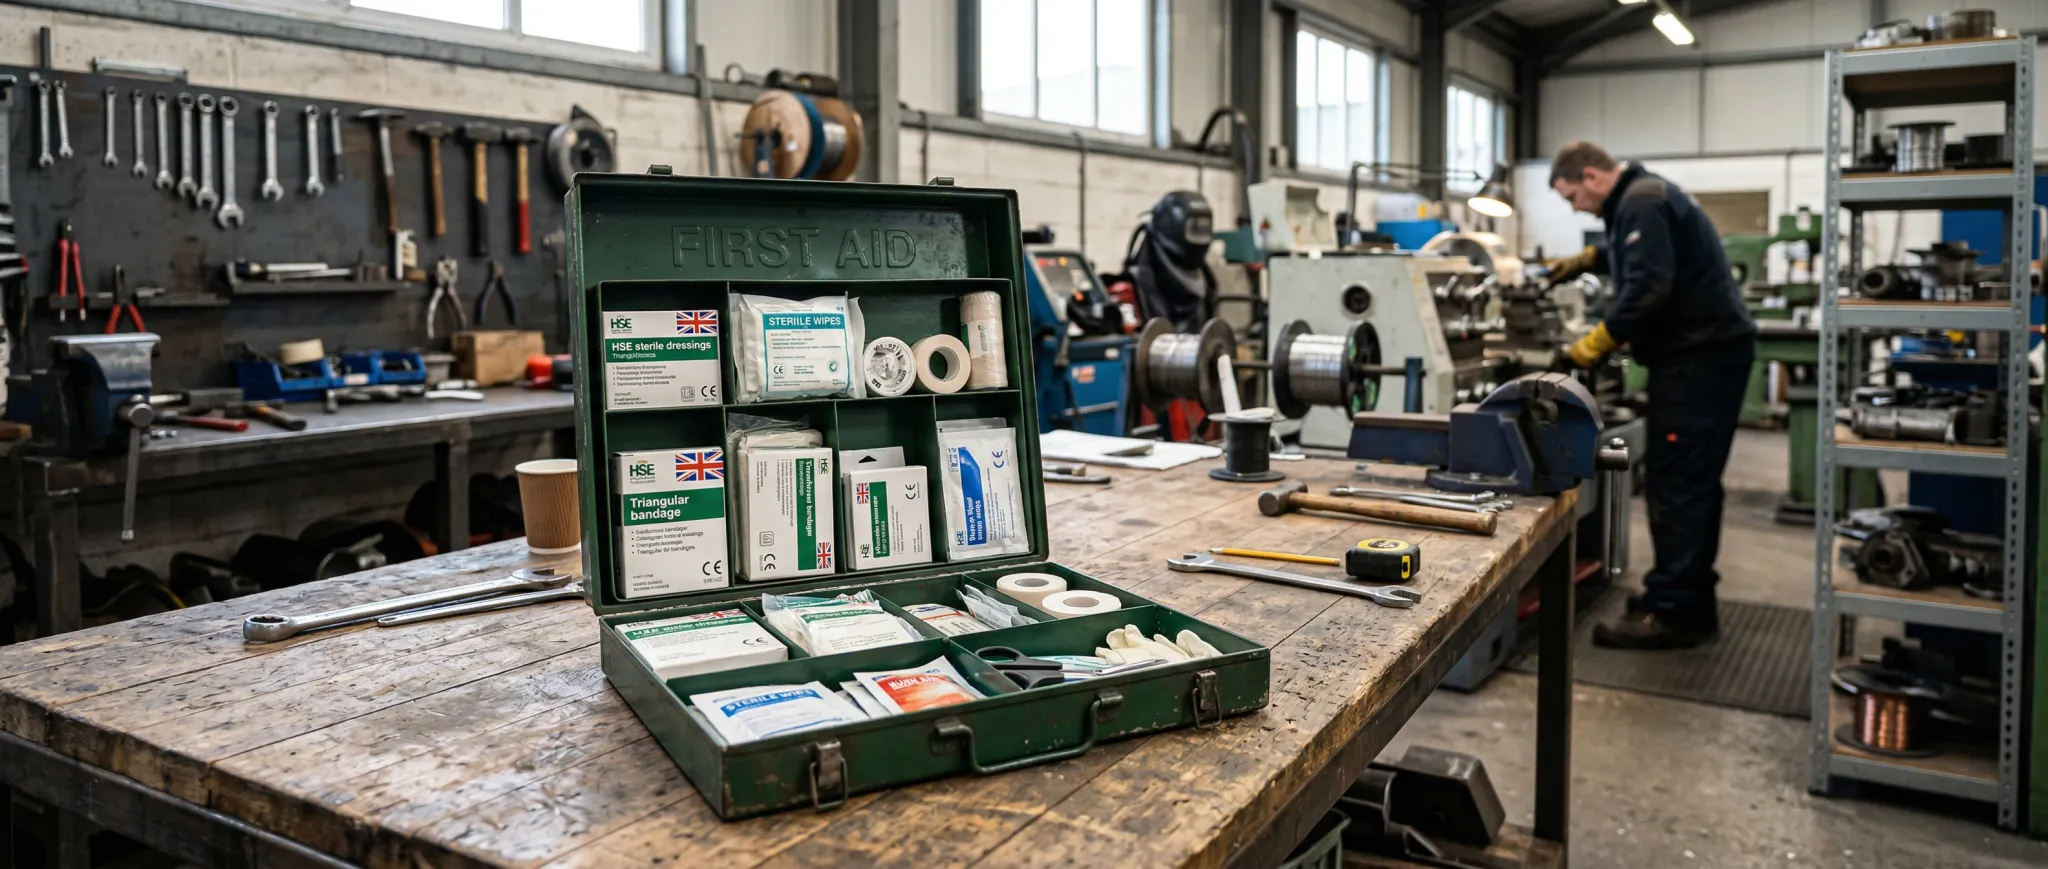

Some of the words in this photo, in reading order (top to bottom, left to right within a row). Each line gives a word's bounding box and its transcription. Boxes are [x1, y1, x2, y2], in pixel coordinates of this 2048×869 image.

[672, 225, 819, 267] FIRST
[836, 229, 917, 268] AID
[611, 318, 632, 329] HSE
[813, 317, 841, 325] WIPES
[612, 342, 633, 351] HSE
[635, 341, 664, 351] sterile
[666, 340, 711, 351] dressings
[630, 463, 655, 477] HSE
[630, 494, 689, 509] Triangular
[631, 508, 681, 520] bandage
[725, 693, 779, 712] STERILE
